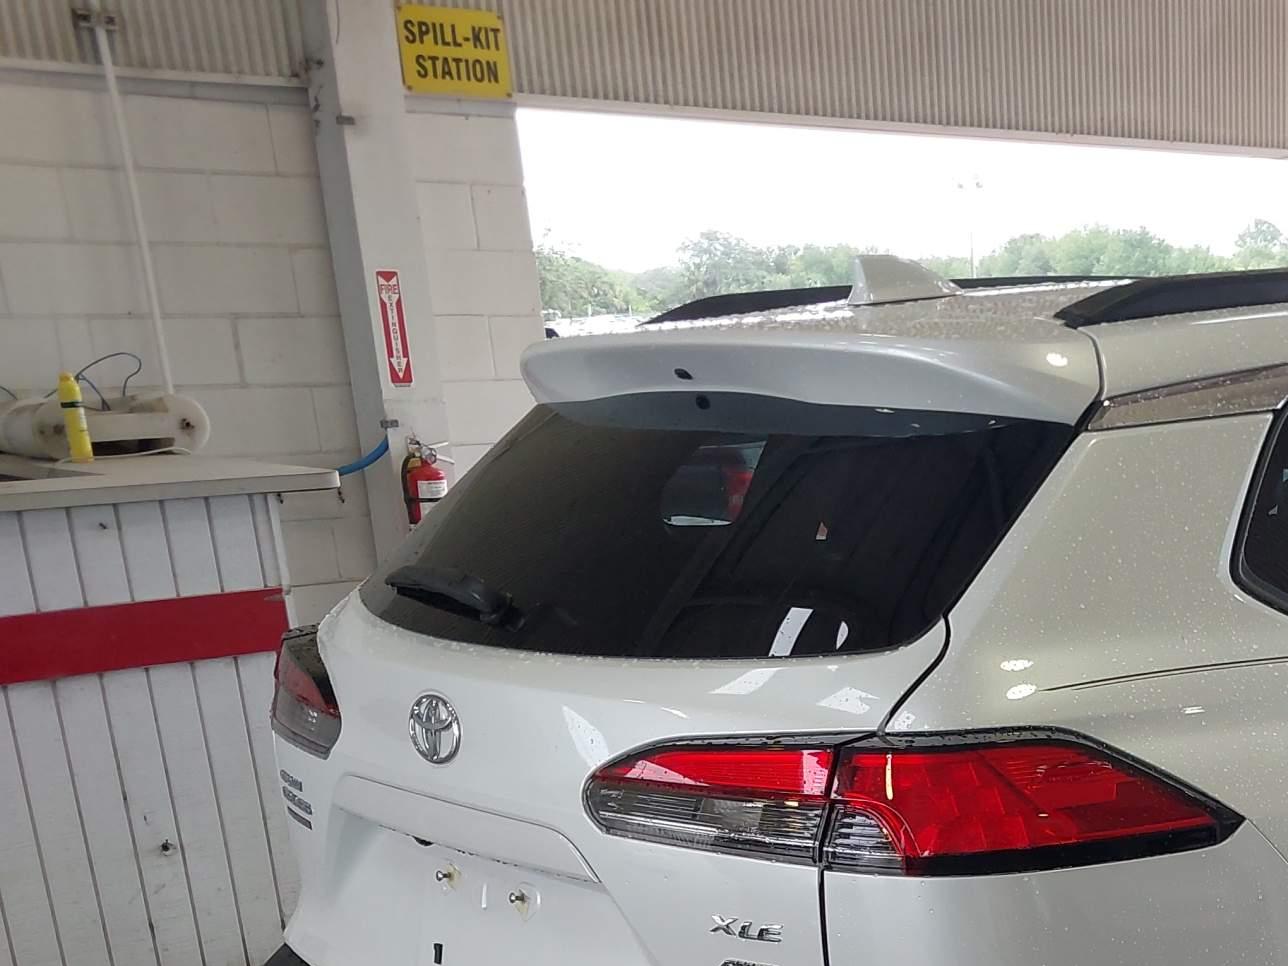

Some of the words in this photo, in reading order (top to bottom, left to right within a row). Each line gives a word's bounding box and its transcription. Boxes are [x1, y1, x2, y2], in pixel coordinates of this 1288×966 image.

[403, 19, 500, 51] SPILL-KIT
[415, 54, 499, 84] STATION
[380, 284, 400, 295] FIRE
[387, 294, 403, 373] EXTINGUISHER
[709, 914, 784, 943] XLE
